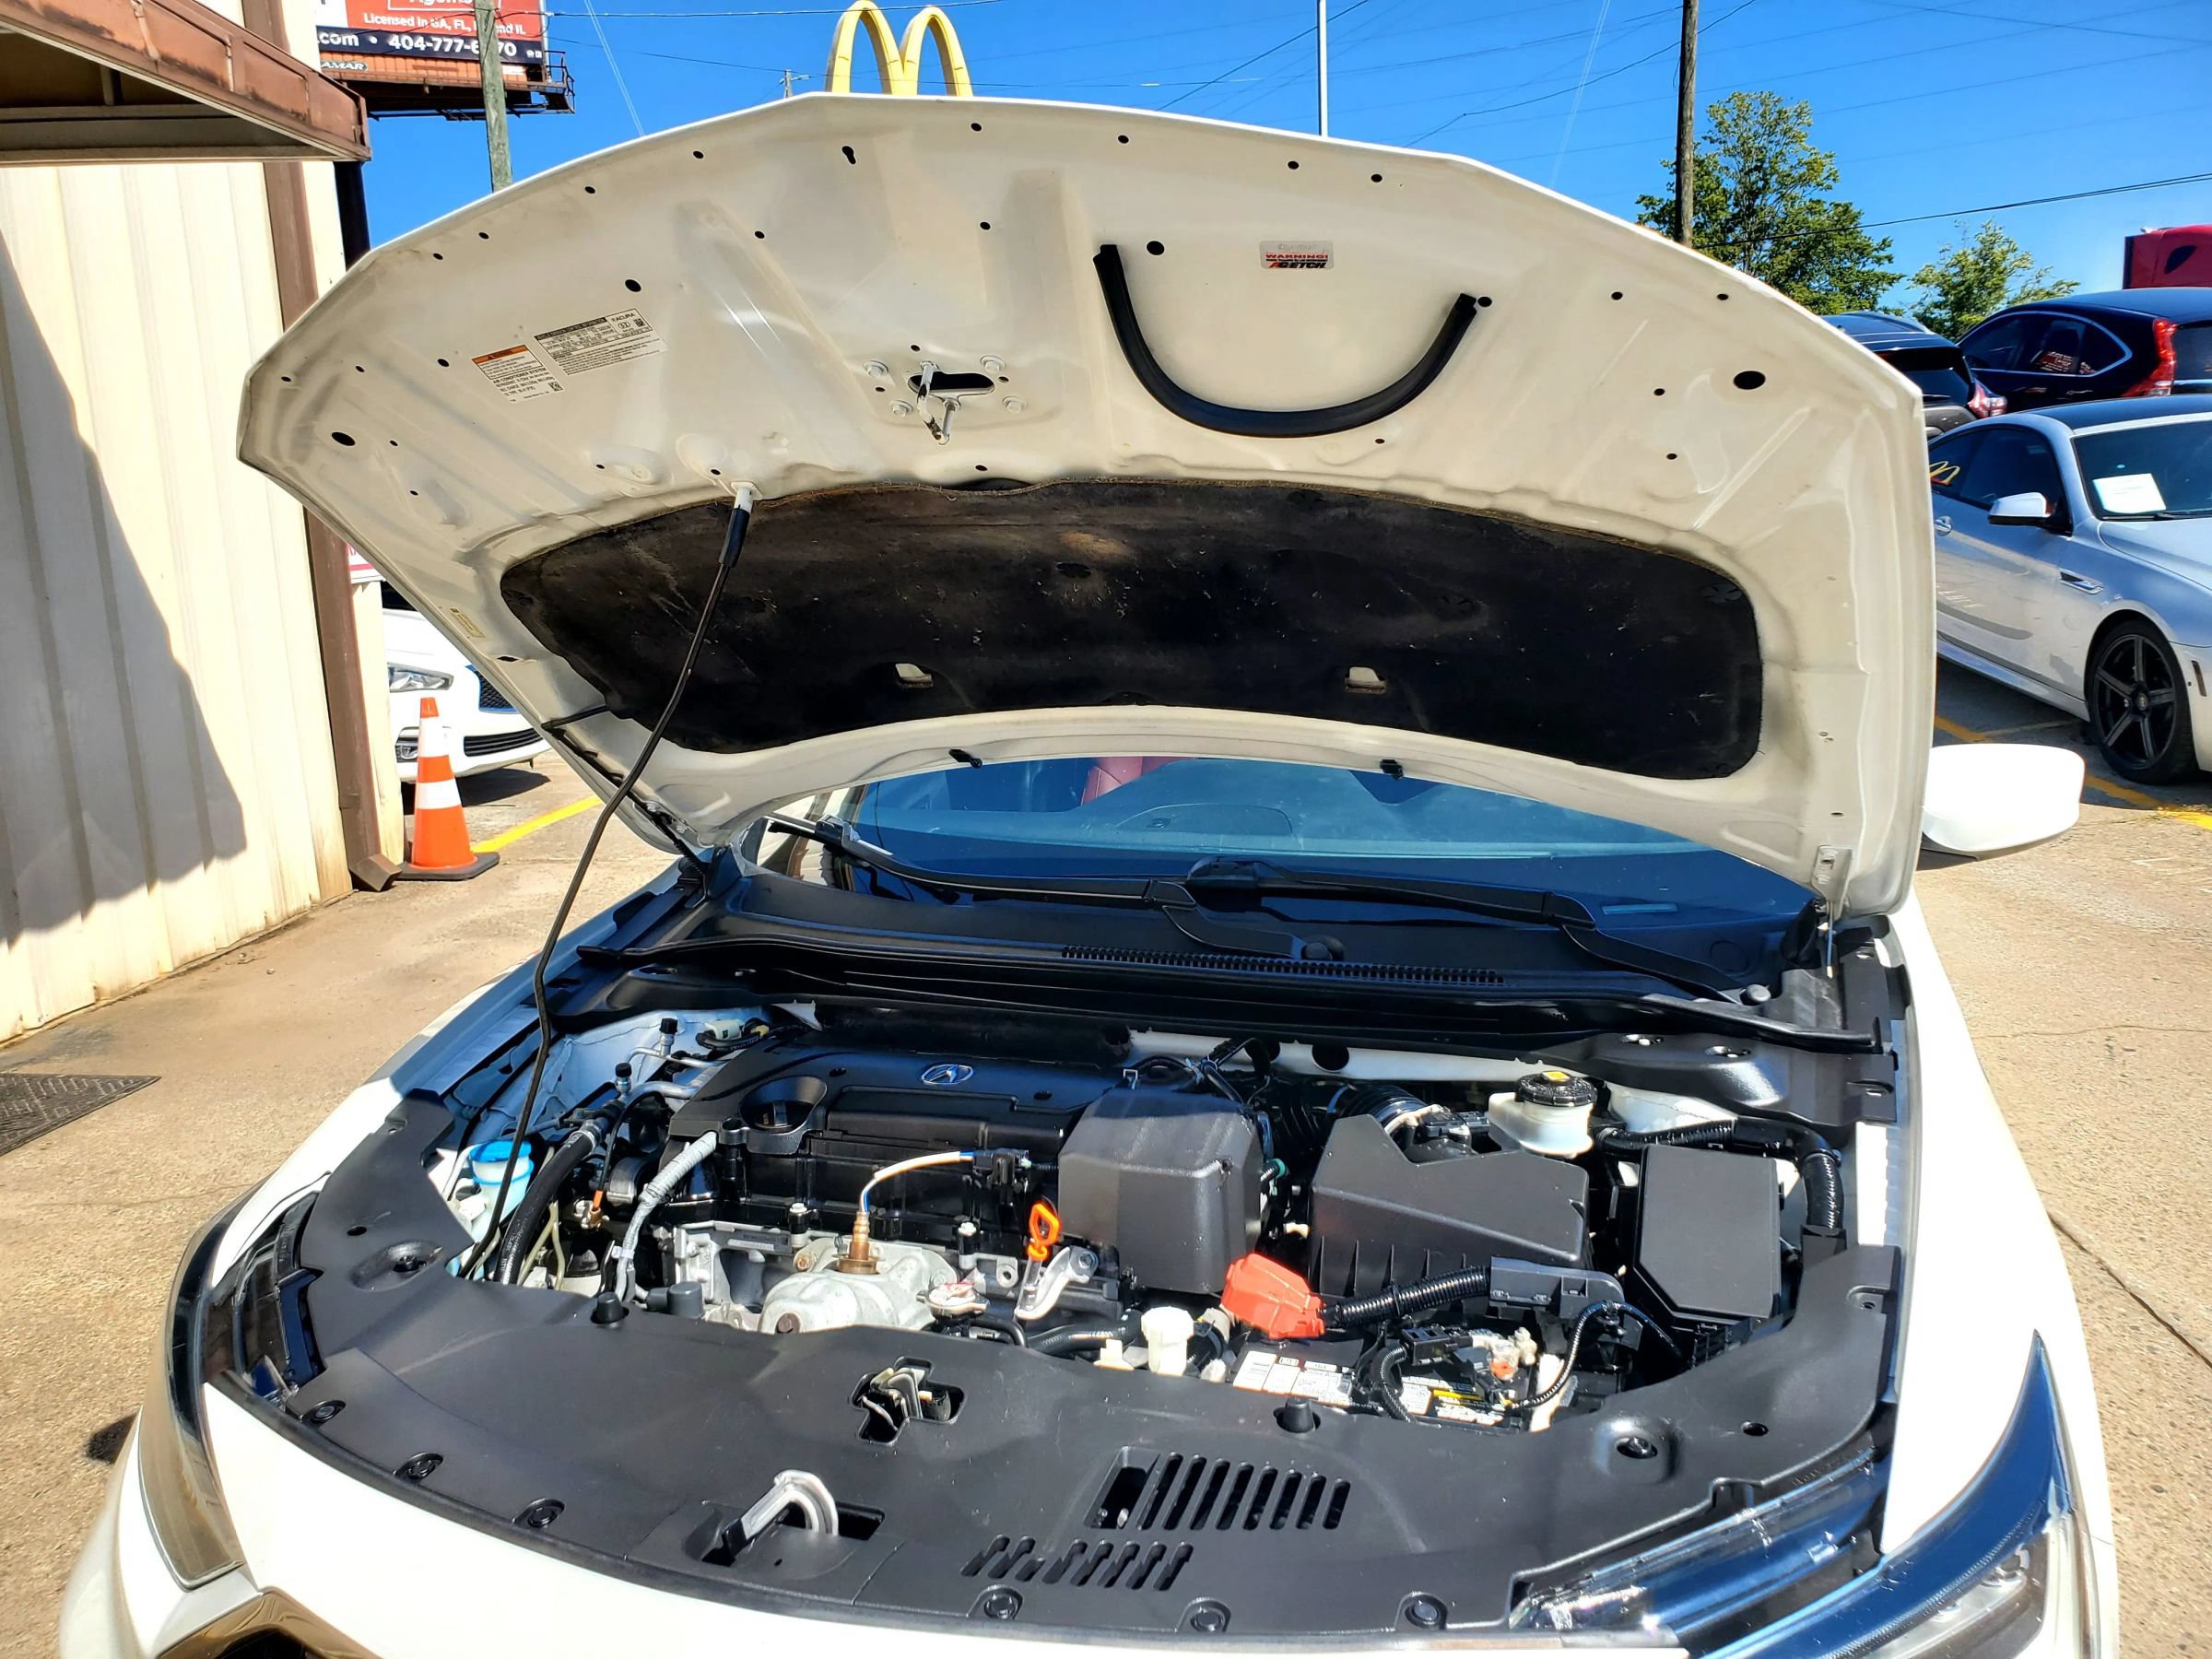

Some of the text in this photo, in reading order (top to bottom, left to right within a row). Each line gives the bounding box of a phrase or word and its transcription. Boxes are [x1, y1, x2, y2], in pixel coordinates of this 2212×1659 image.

[363, 12, 415, 27] Licensed
[453, 18, 472, 32] FL,
[515, 24, 526, 35] IL
[388, 33, 517, 56] 404-777-670
[321, 61, 365, 70] AMAR
